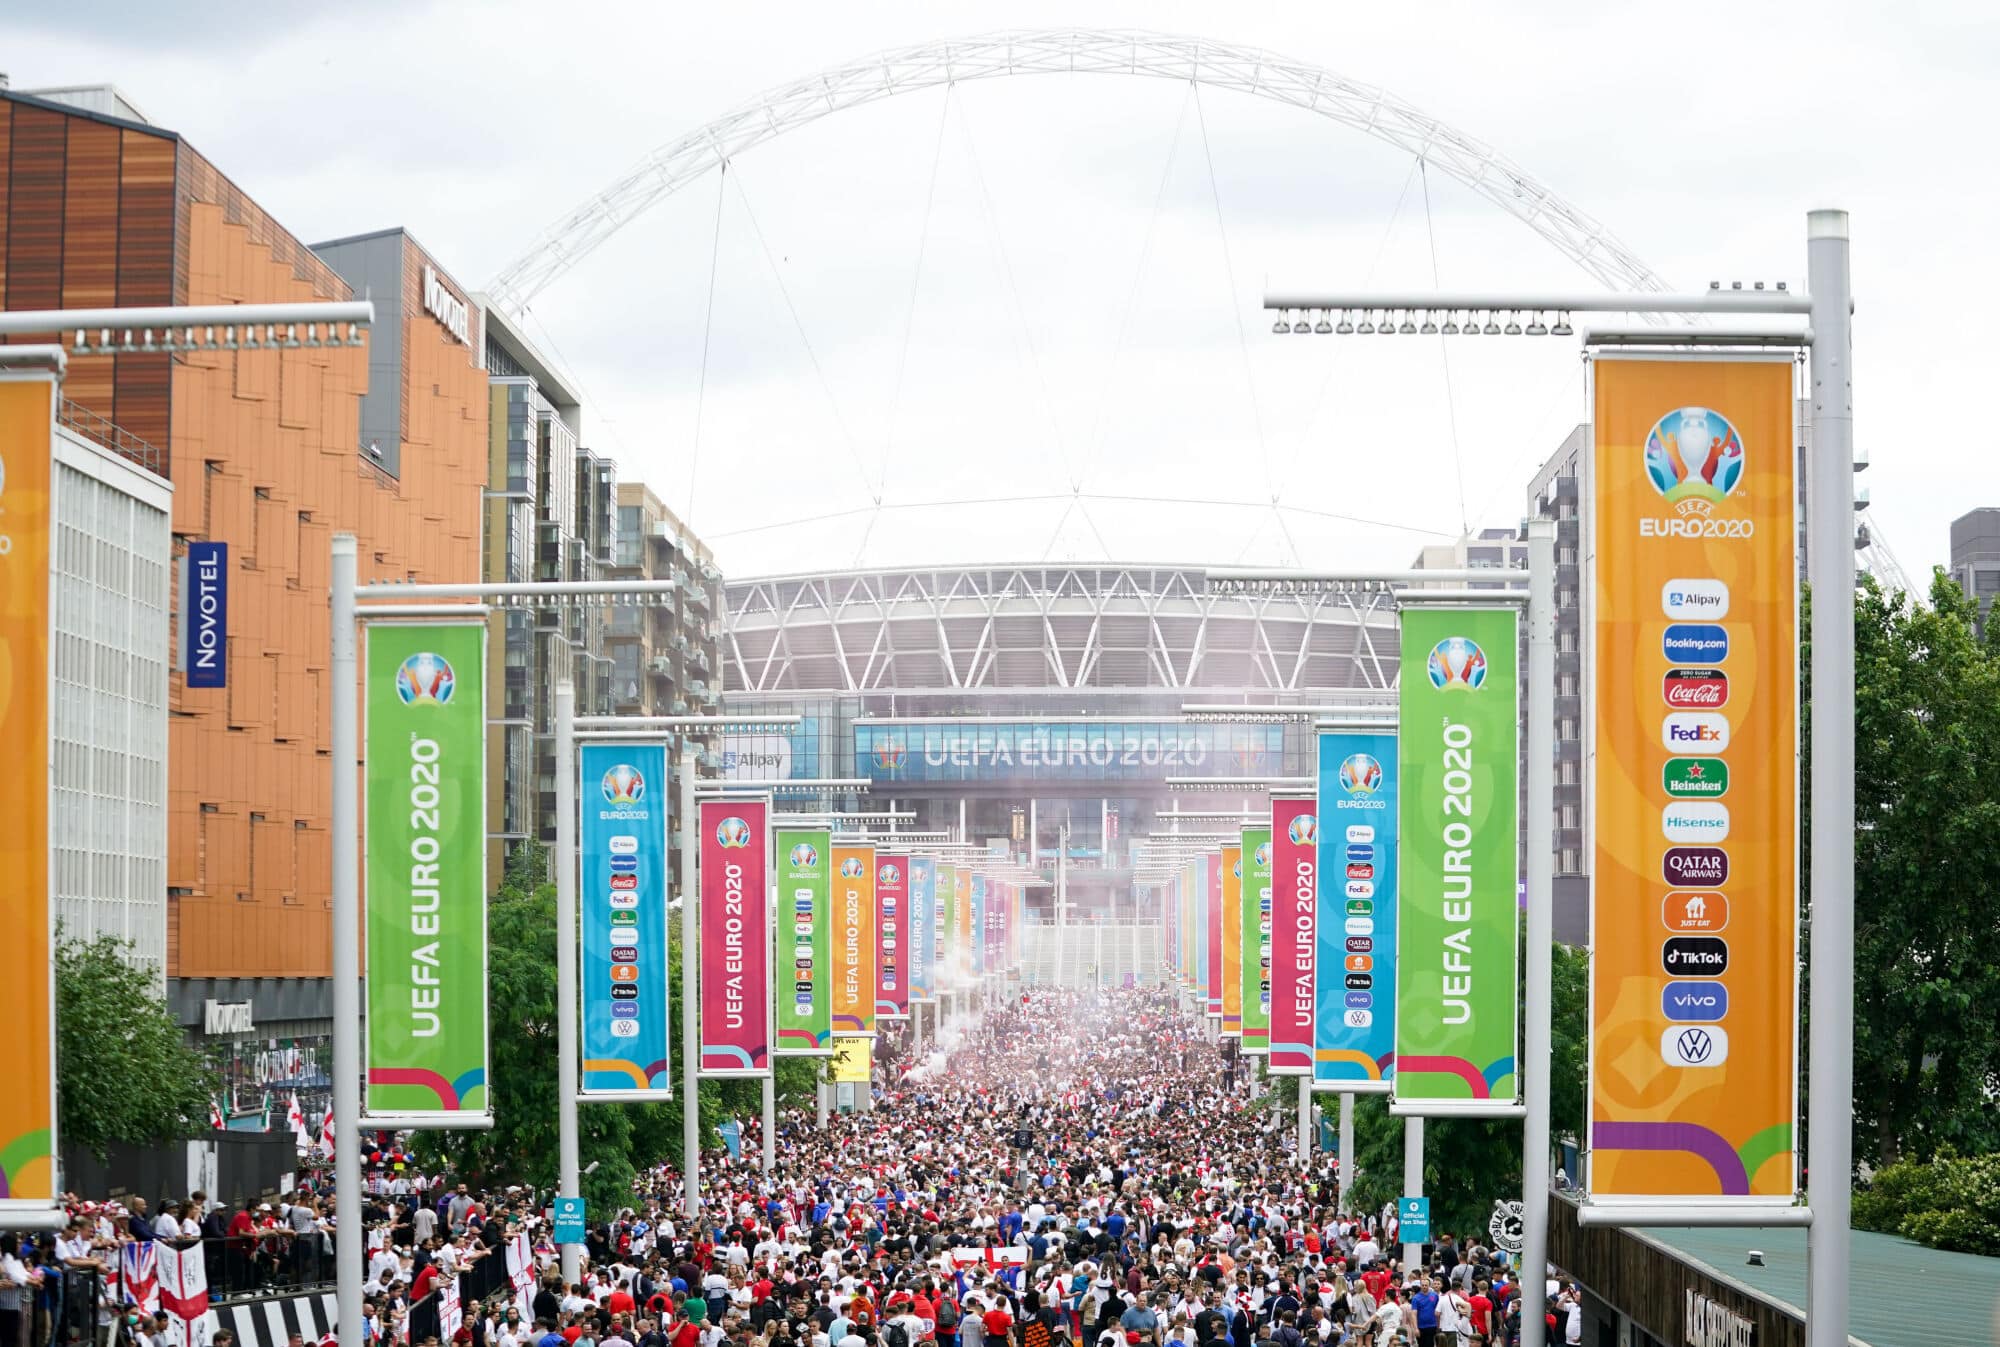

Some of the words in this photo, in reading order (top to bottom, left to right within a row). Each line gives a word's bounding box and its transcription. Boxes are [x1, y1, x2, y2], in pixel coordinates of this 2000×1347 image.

[425, 266, 471, 346] NOVOTEL
[1676, 501, 1712, 515] UEFA
[1640, 518, 1754, 538] EURO2020
[196, 551, 217, 667] NOVOTEL
[1685, 594, 1720, 606] Alipay
[1665, 637, 1725, 649] Booking.com
[1669, 684, 1721, 702] Coca-Cola
[1671, 725, 1720, 741] FedEx
[740, 752, 782, 768] Alipay
[925, 738, 1013, 766] UEFA
[1020, 738, 1114, 766] EURO
[1120, 738, 1207, 766] 2020
[1443, 724, 1472, 816] 2020
[411, 738, 440, 831] 2020
[1670, 780, 1721, 791] Heineken
[1667, 817, 1724, 828] Hisense
[1443, 822, 1472, 921] EURO
[1670, 856, 1721, 870] QATAR
[1682, 869, 1722, 878] AIRWAYS
[411, 837, 440, 935] EURO
[726, 864, 742, 915] 2020
[1296, 862, 1313, 913] 2020
[846, 890, 858, 925] 2020
[726, 918, 743, 972] EURO
[846, 927, 858, 965] EURO
[1296, 916, 1313, 970] EURO
[1681, 952, 1723, 964] TikTok
[411, 942, 440, 1037] UEFA
[847, 967, 858, 1004] UEFA
[1443, 928, 1472, 1024] UEFA
[205, 999, 255, 1034] NOVOTEL
[727, 976, 743, 1028] UEFA
[1296, 974, 1312, 1026] UEFA
[1674, 994, 1716, 1006] vivo
